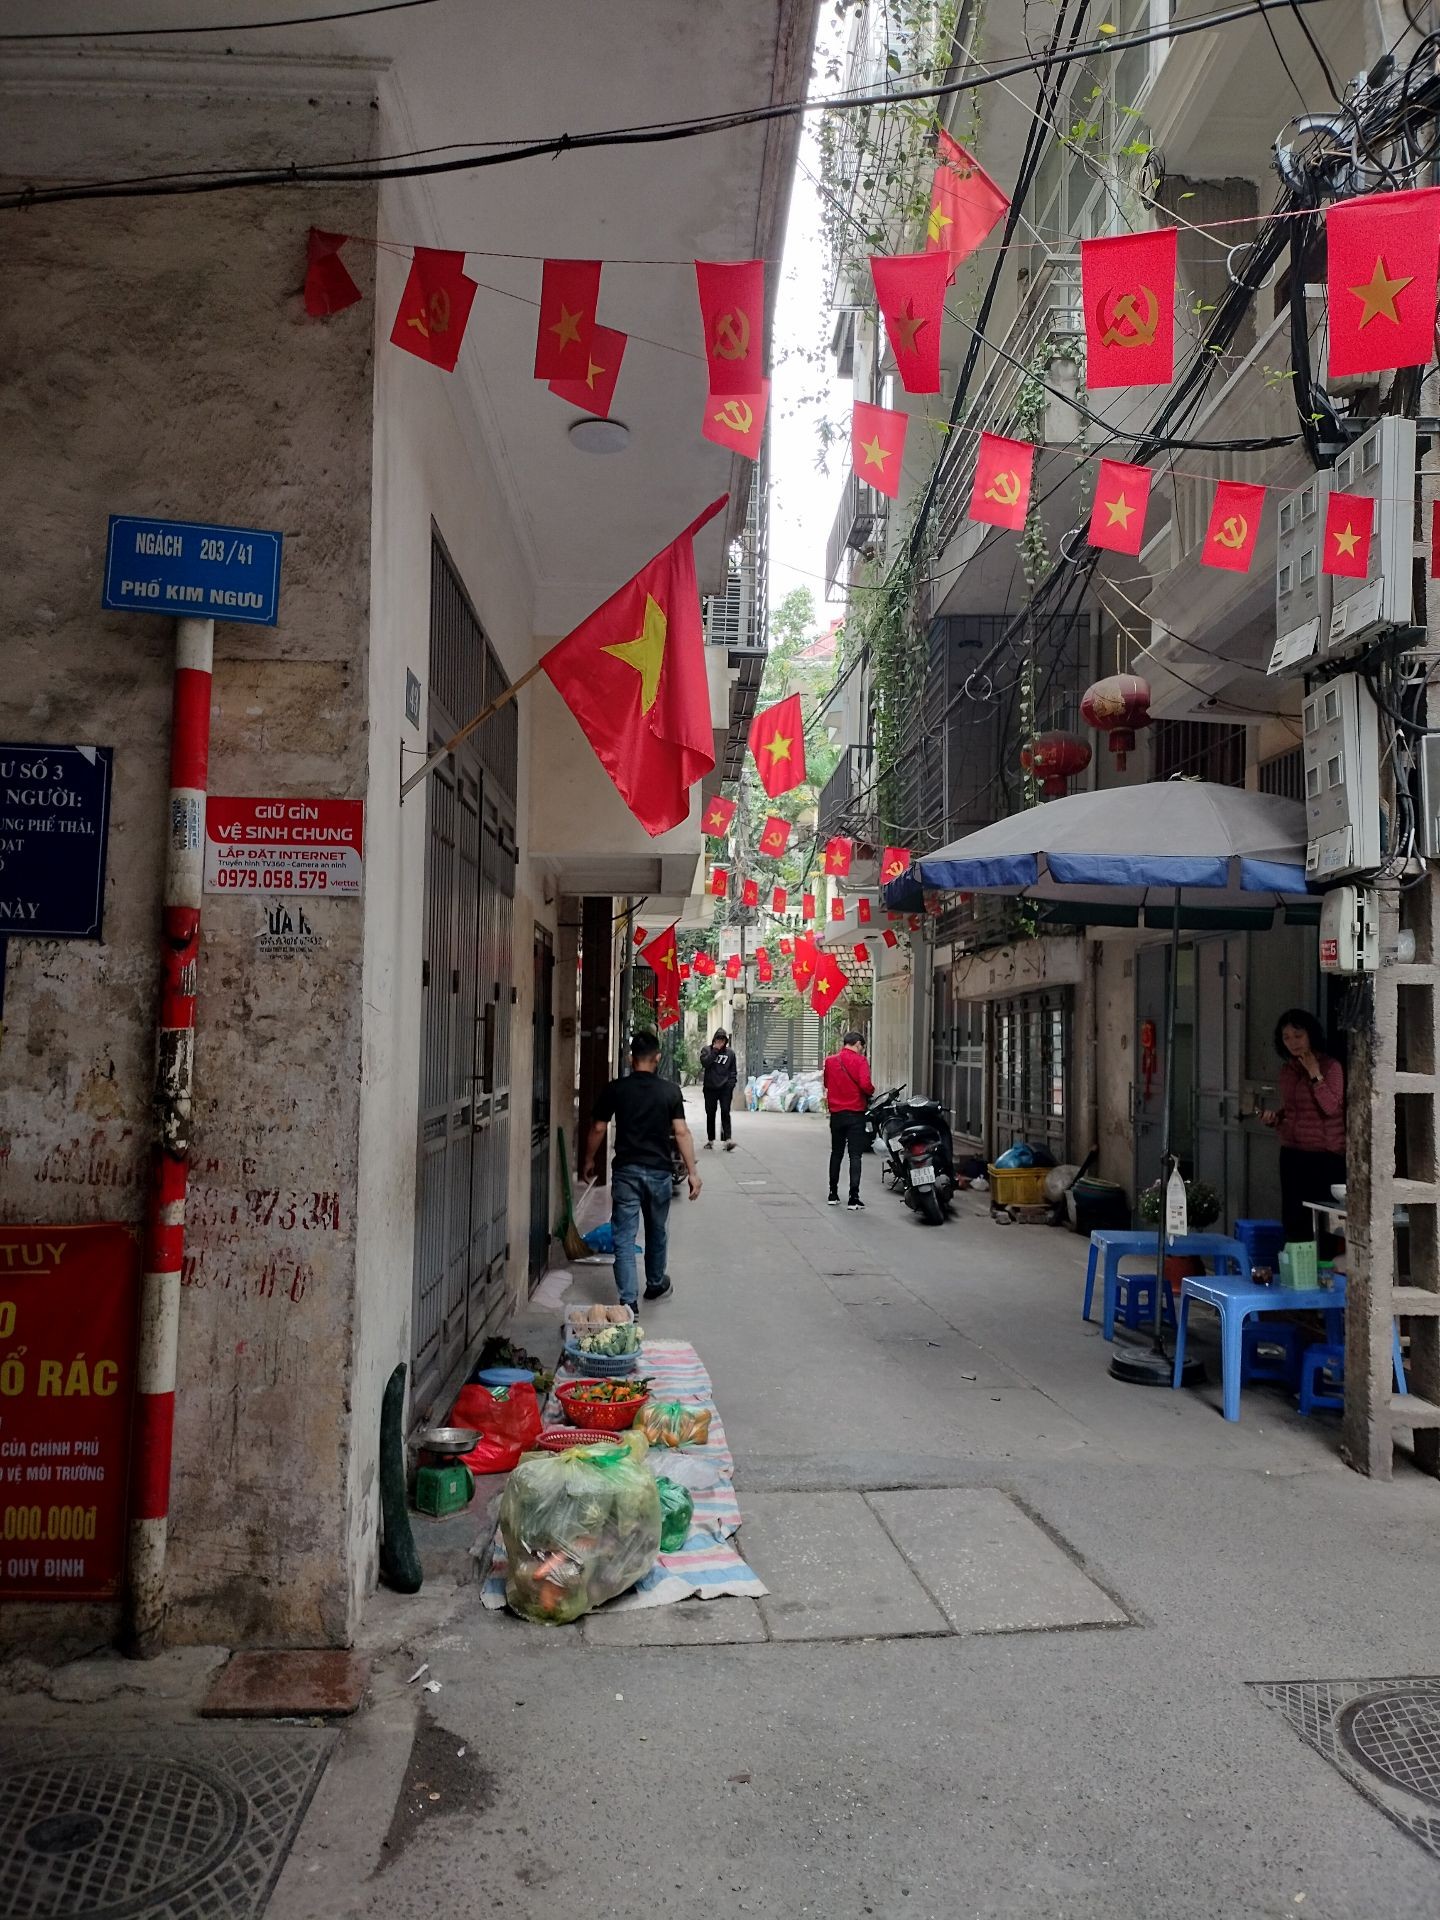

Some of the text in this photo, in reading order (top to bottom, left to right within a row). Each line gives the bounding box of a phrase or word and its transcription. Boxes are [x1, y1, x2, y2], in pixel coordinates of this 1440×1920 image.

[135, 529, 253, 565] NGÁCH 203/41
[121, 577, 264, 609] PHỐ KIM NGƯU
[19, 757, 48, 780] SỐ
[52, 764, 64, 780] 3
[6, 786, 82, 807] NGƯỜI:
[255, 803, 319, 820] GIỮ GÌN
[28, 815, 55, 832] PHẾ
[58, 817, 95, 835] THẢI,
[218, 822, 353, 841] VỆ SINH CHUNG
[218, 846, 347, 861] LẮP ĐẶT INTERNET
[262, 860, 285, 868] TV360
[292, 861, 319, 869] Camera
[218, 868, 359, 889] 0979.058.579 viettel
[0, 897, 40, 919] NÀY
[0, 1243, 67, 1266] TUY
[37, 1352, 119, 1396] RÁC
[1, 1436, 100, 1457] CỦA CHÍNH PHỦ
[7, 1464, 22, 1484] VỆ
[27, 1463, 52, 1481] MÔI
[56, 1462, 105, 1482] TRƯỜNG
[8, 1558, 40, 1579] QUY
[45, 1558, 84, 1581] ĐỊNH
